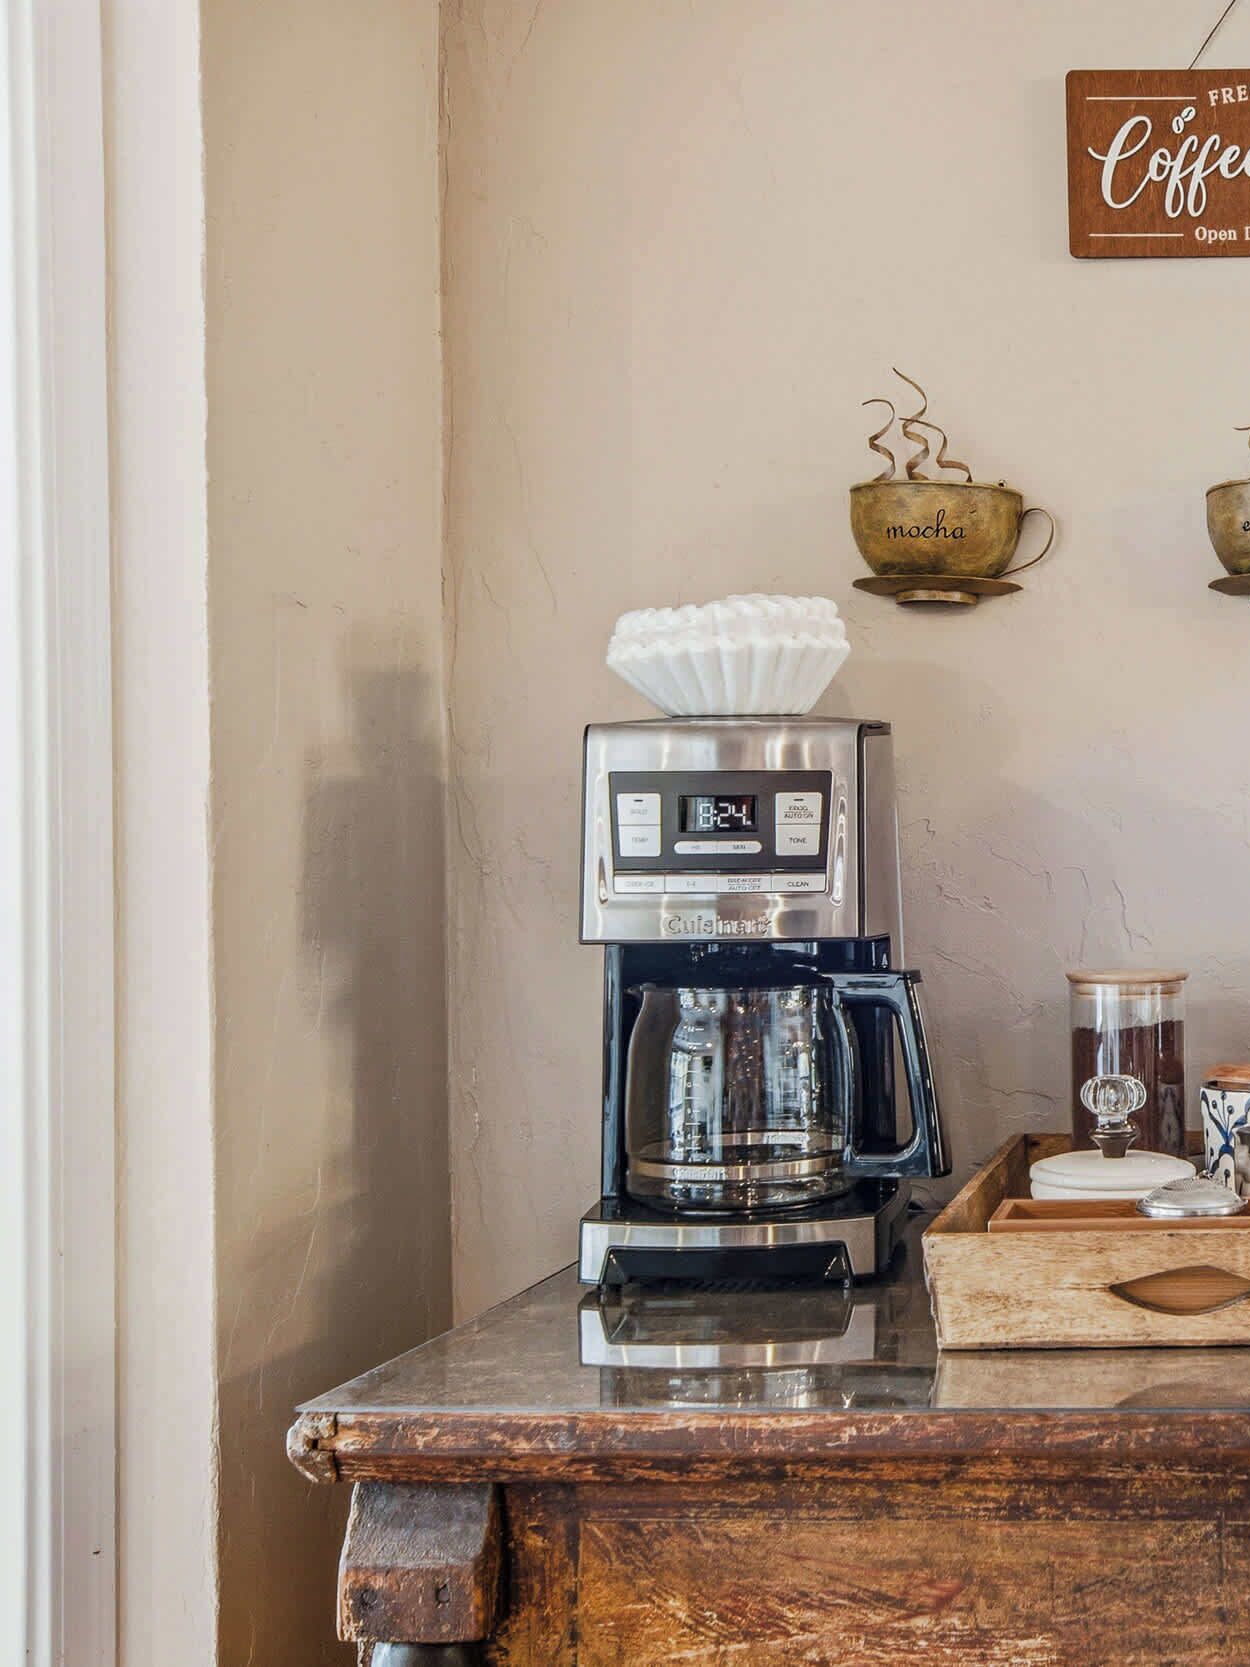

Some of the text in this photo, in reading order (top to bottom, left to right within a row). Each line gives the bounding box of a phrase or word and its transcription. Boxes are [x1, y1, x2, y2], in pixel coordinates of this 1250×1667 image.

[1194, 226, 1237, 244] Open
[886, 508, 967, 539] mocha
[699, 803, 747, 828] 8:24
[668, 913, 771, 936] Cuisinart
